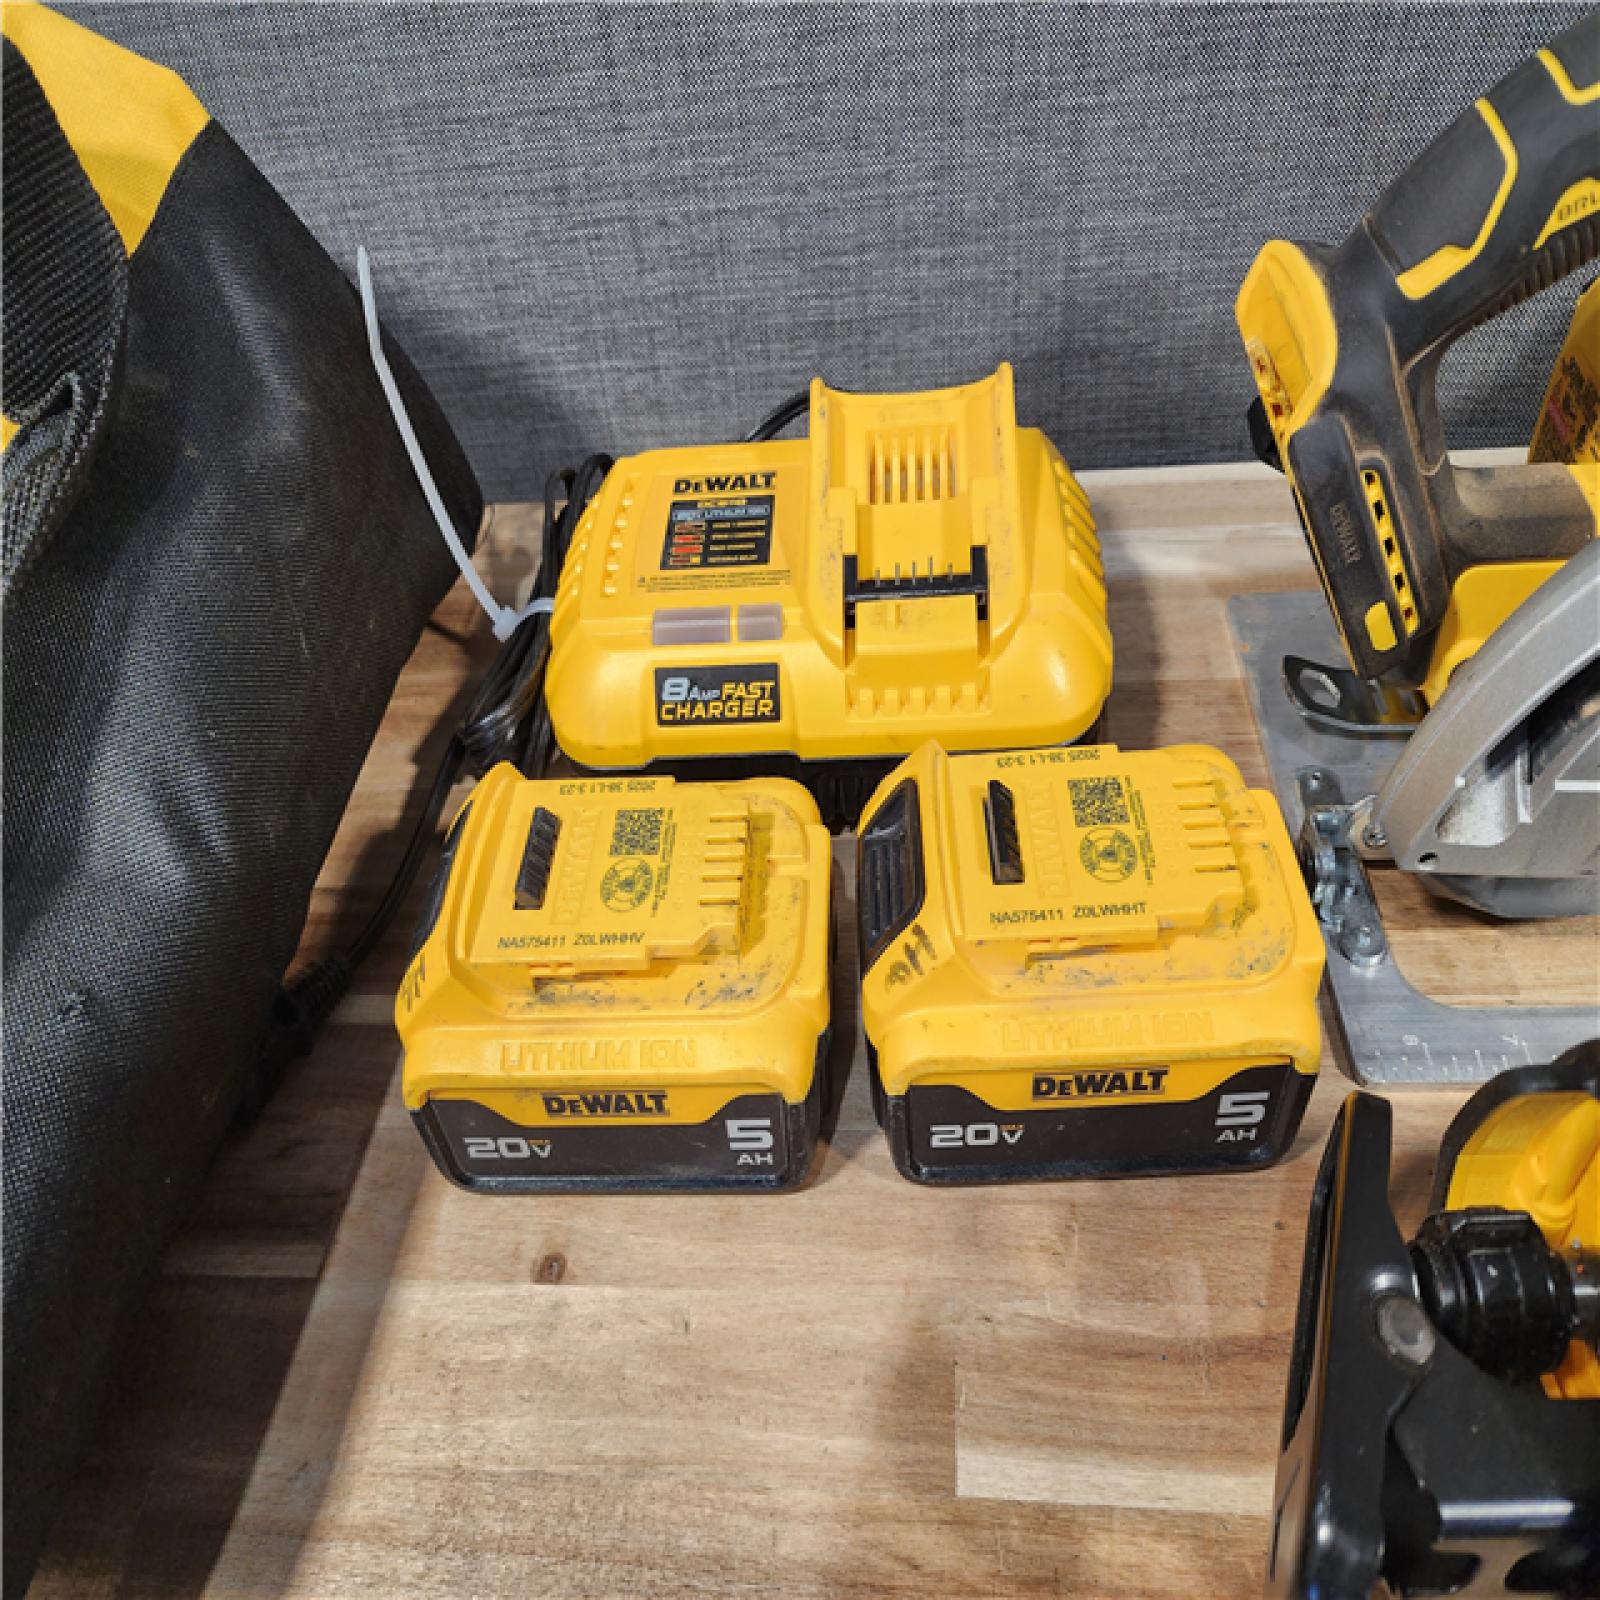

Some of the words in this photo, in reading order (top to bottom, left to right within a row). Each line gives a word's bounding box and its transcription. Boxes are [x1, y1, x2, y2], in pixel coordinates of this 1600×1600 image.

[721, 681, 775, 700] FAST
[661, 699, 774, 720] CHARGER
[1001, 1015, 1146, 1051] LITHIUM
[1151, 1010, 1215, 1043] ION
[501, 1040, 631, 1073] LITHIUM
[639, 1039, 698, 1069] ION
[1032, 1069, 1169, 1098] DEWALT
[542, 1093, 668, 1117] DEWALT
[1214, 1092, 1271, 1127] 5
[724, 1119, 774, 1151] 5
[1216, 1129, 1257, 1143] AH
[736, 1152, 774, 1166] AH
